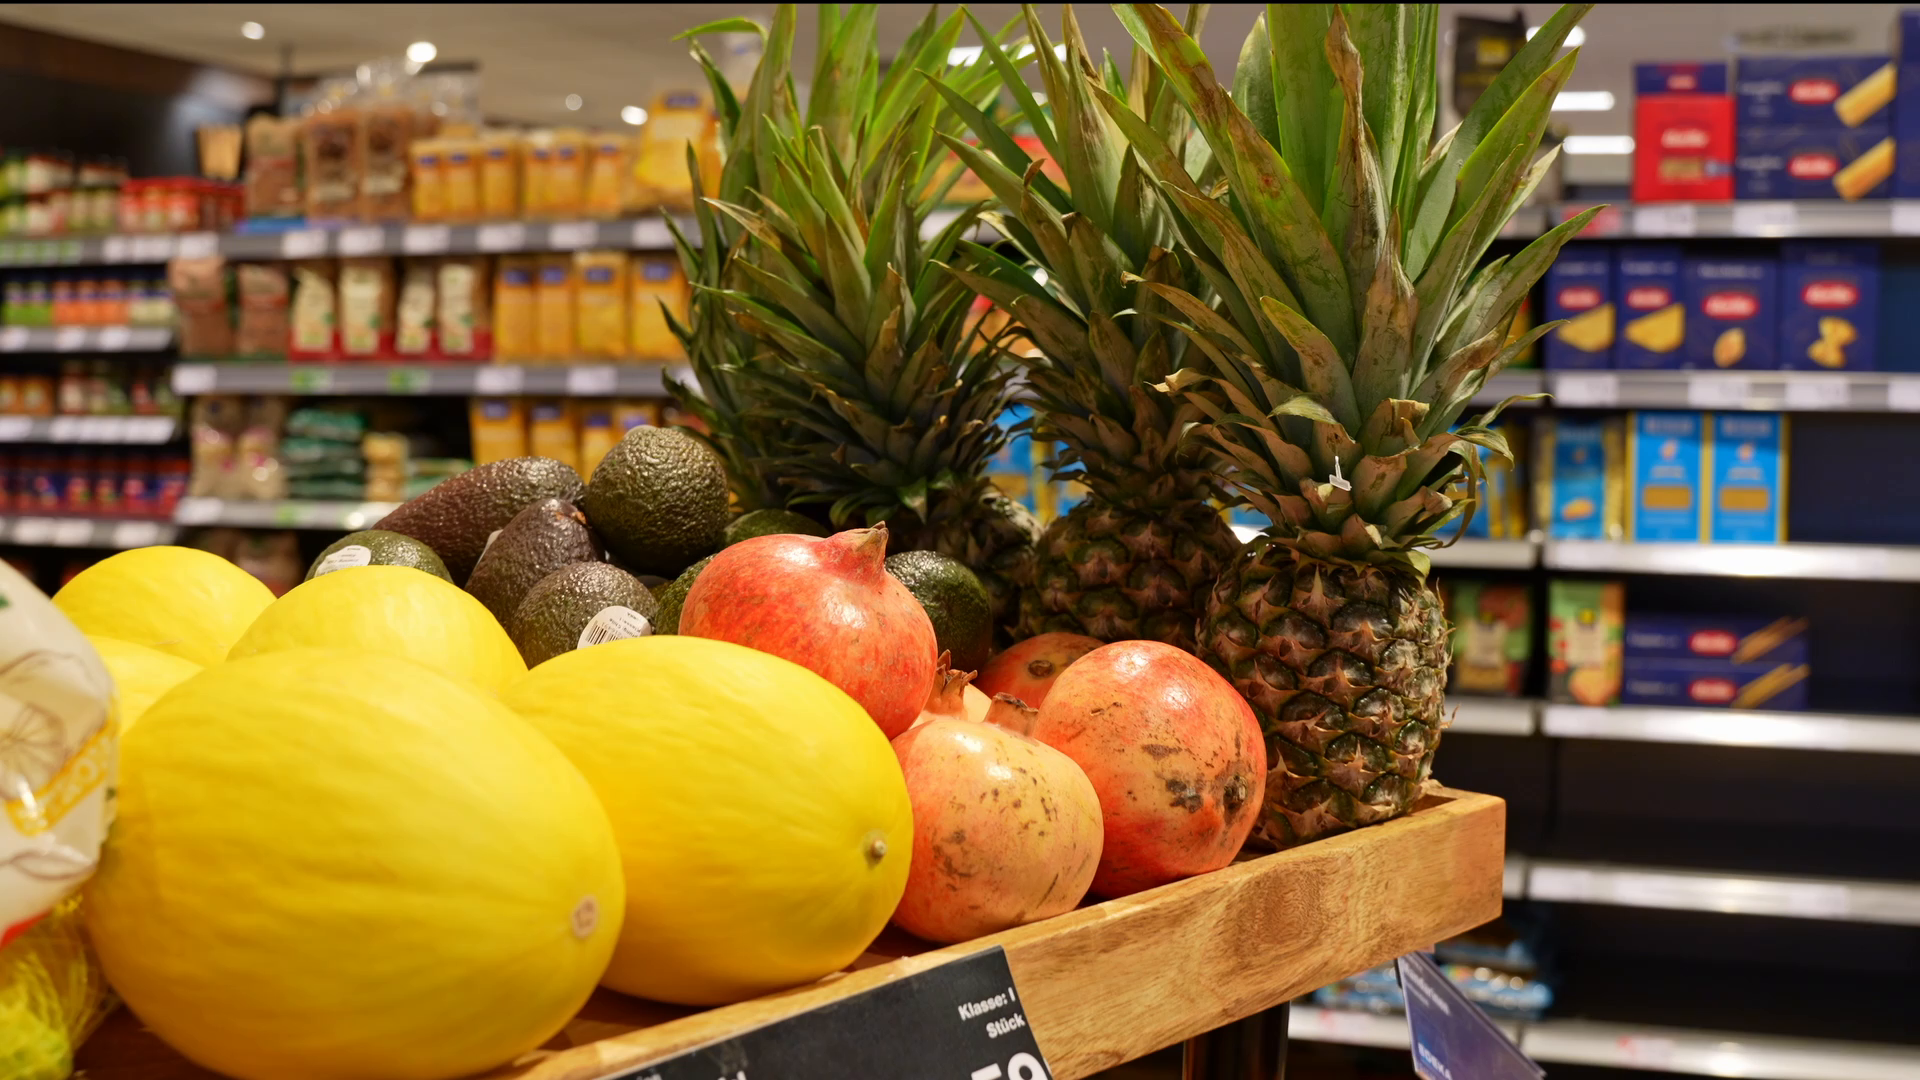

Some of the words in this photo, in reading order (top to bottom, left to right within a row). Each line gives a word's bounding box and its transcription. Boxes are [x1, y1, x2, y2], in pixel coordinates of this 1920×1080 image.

[958, 993, 1008, 1020] Klasse:
[1007, 986, 1016, 1002] I
[985, 1012, 1026, 1039] Stück
